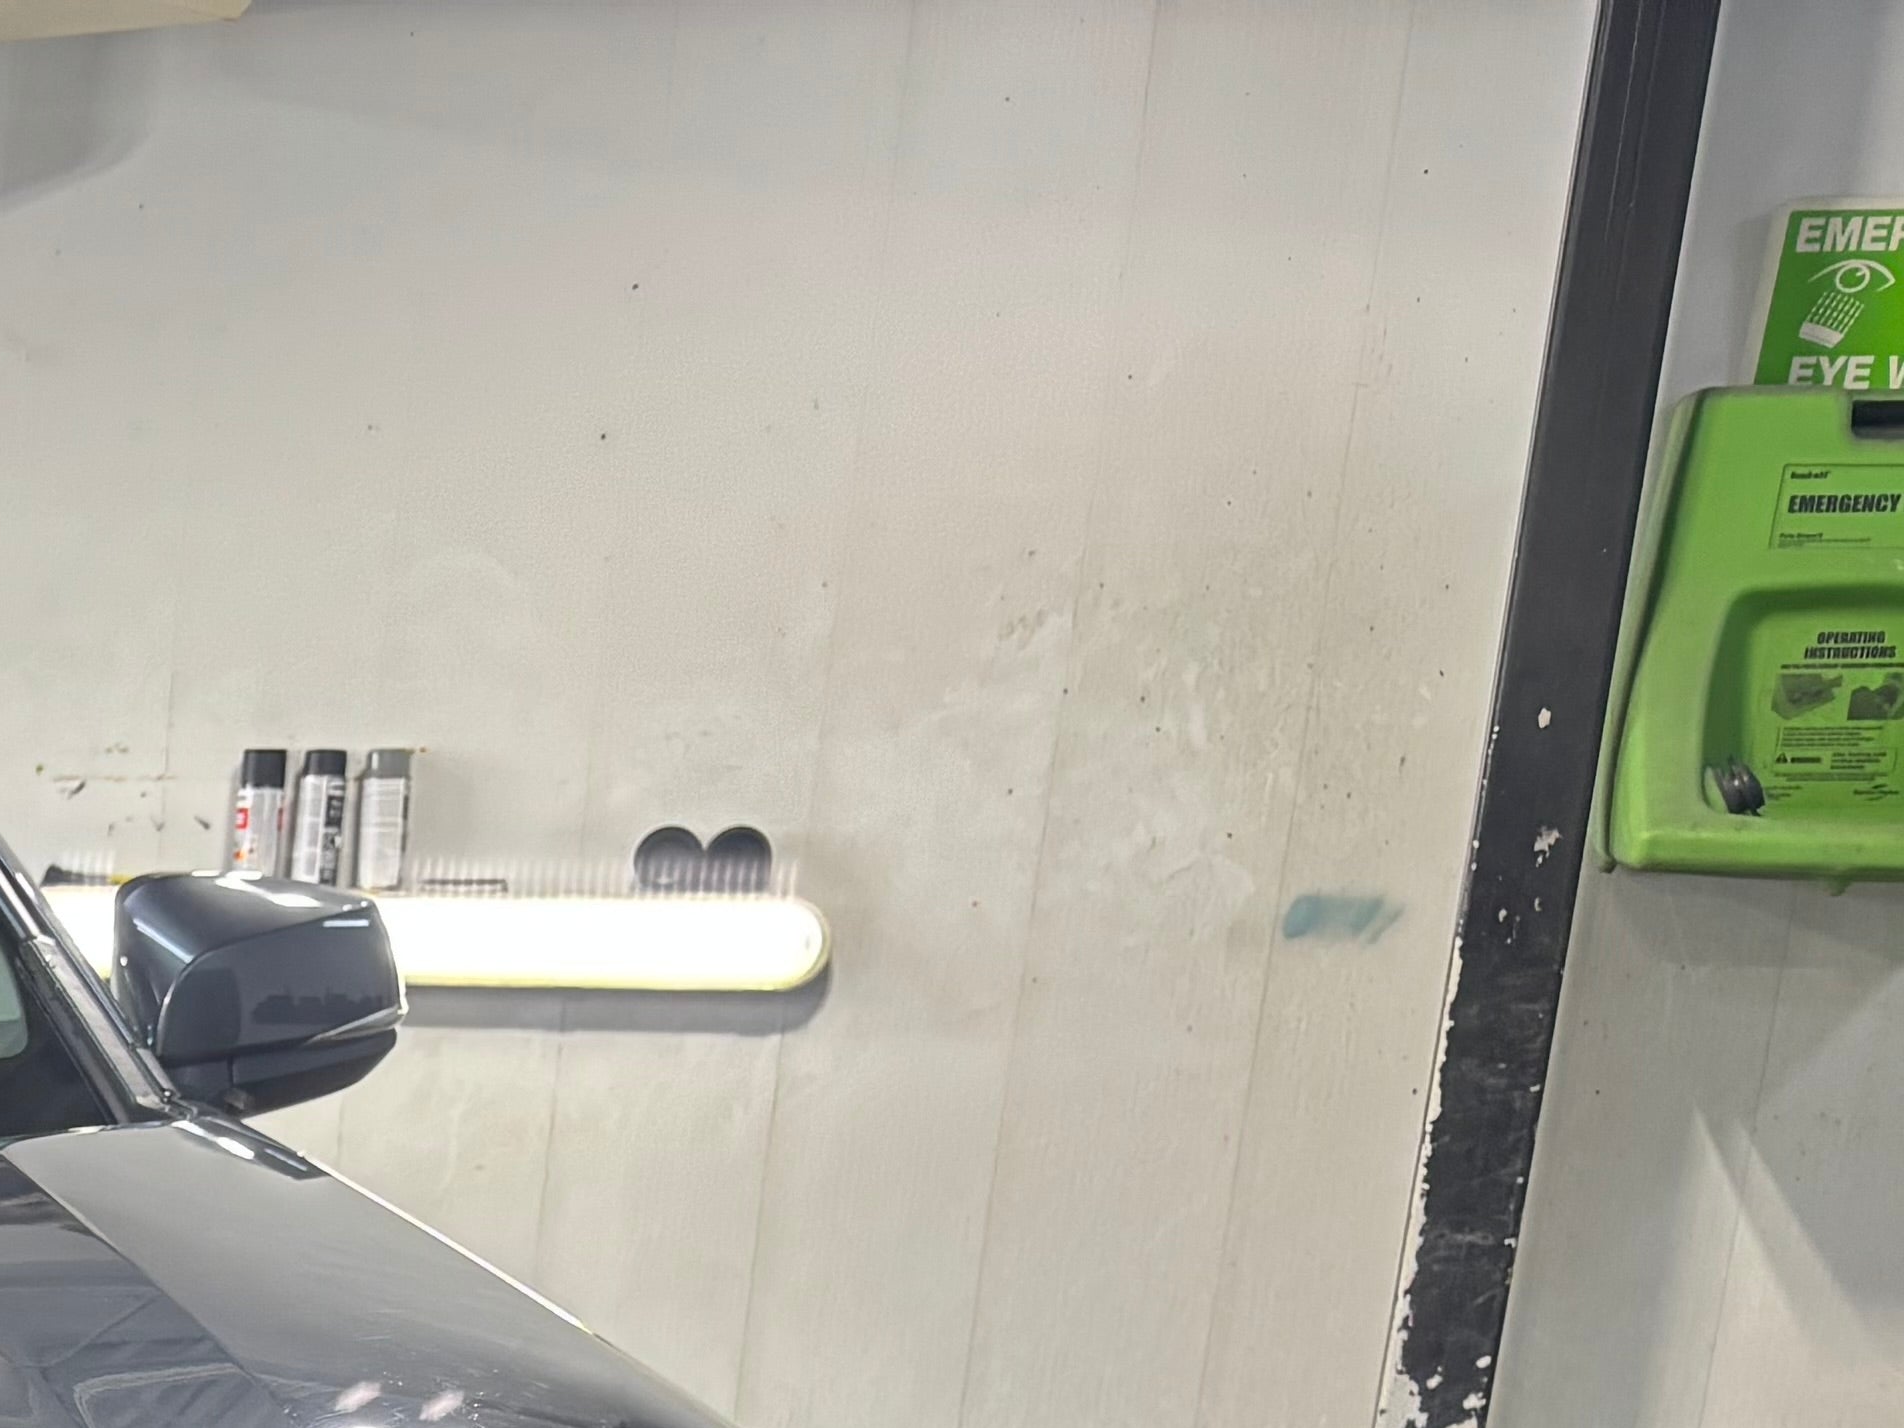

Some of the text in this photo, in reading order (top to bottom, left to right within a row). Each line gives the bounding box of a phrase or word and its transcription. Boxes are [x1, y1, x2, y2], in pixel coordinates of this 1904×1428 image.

[1788, 354, 1875, 390] EYE
[1787, 493, 1902, 514] EMERGENCY
[1817, 631, 1886, 645] OPERATING
[1804, 646, 1897, 659] INSTRUCTIONS
